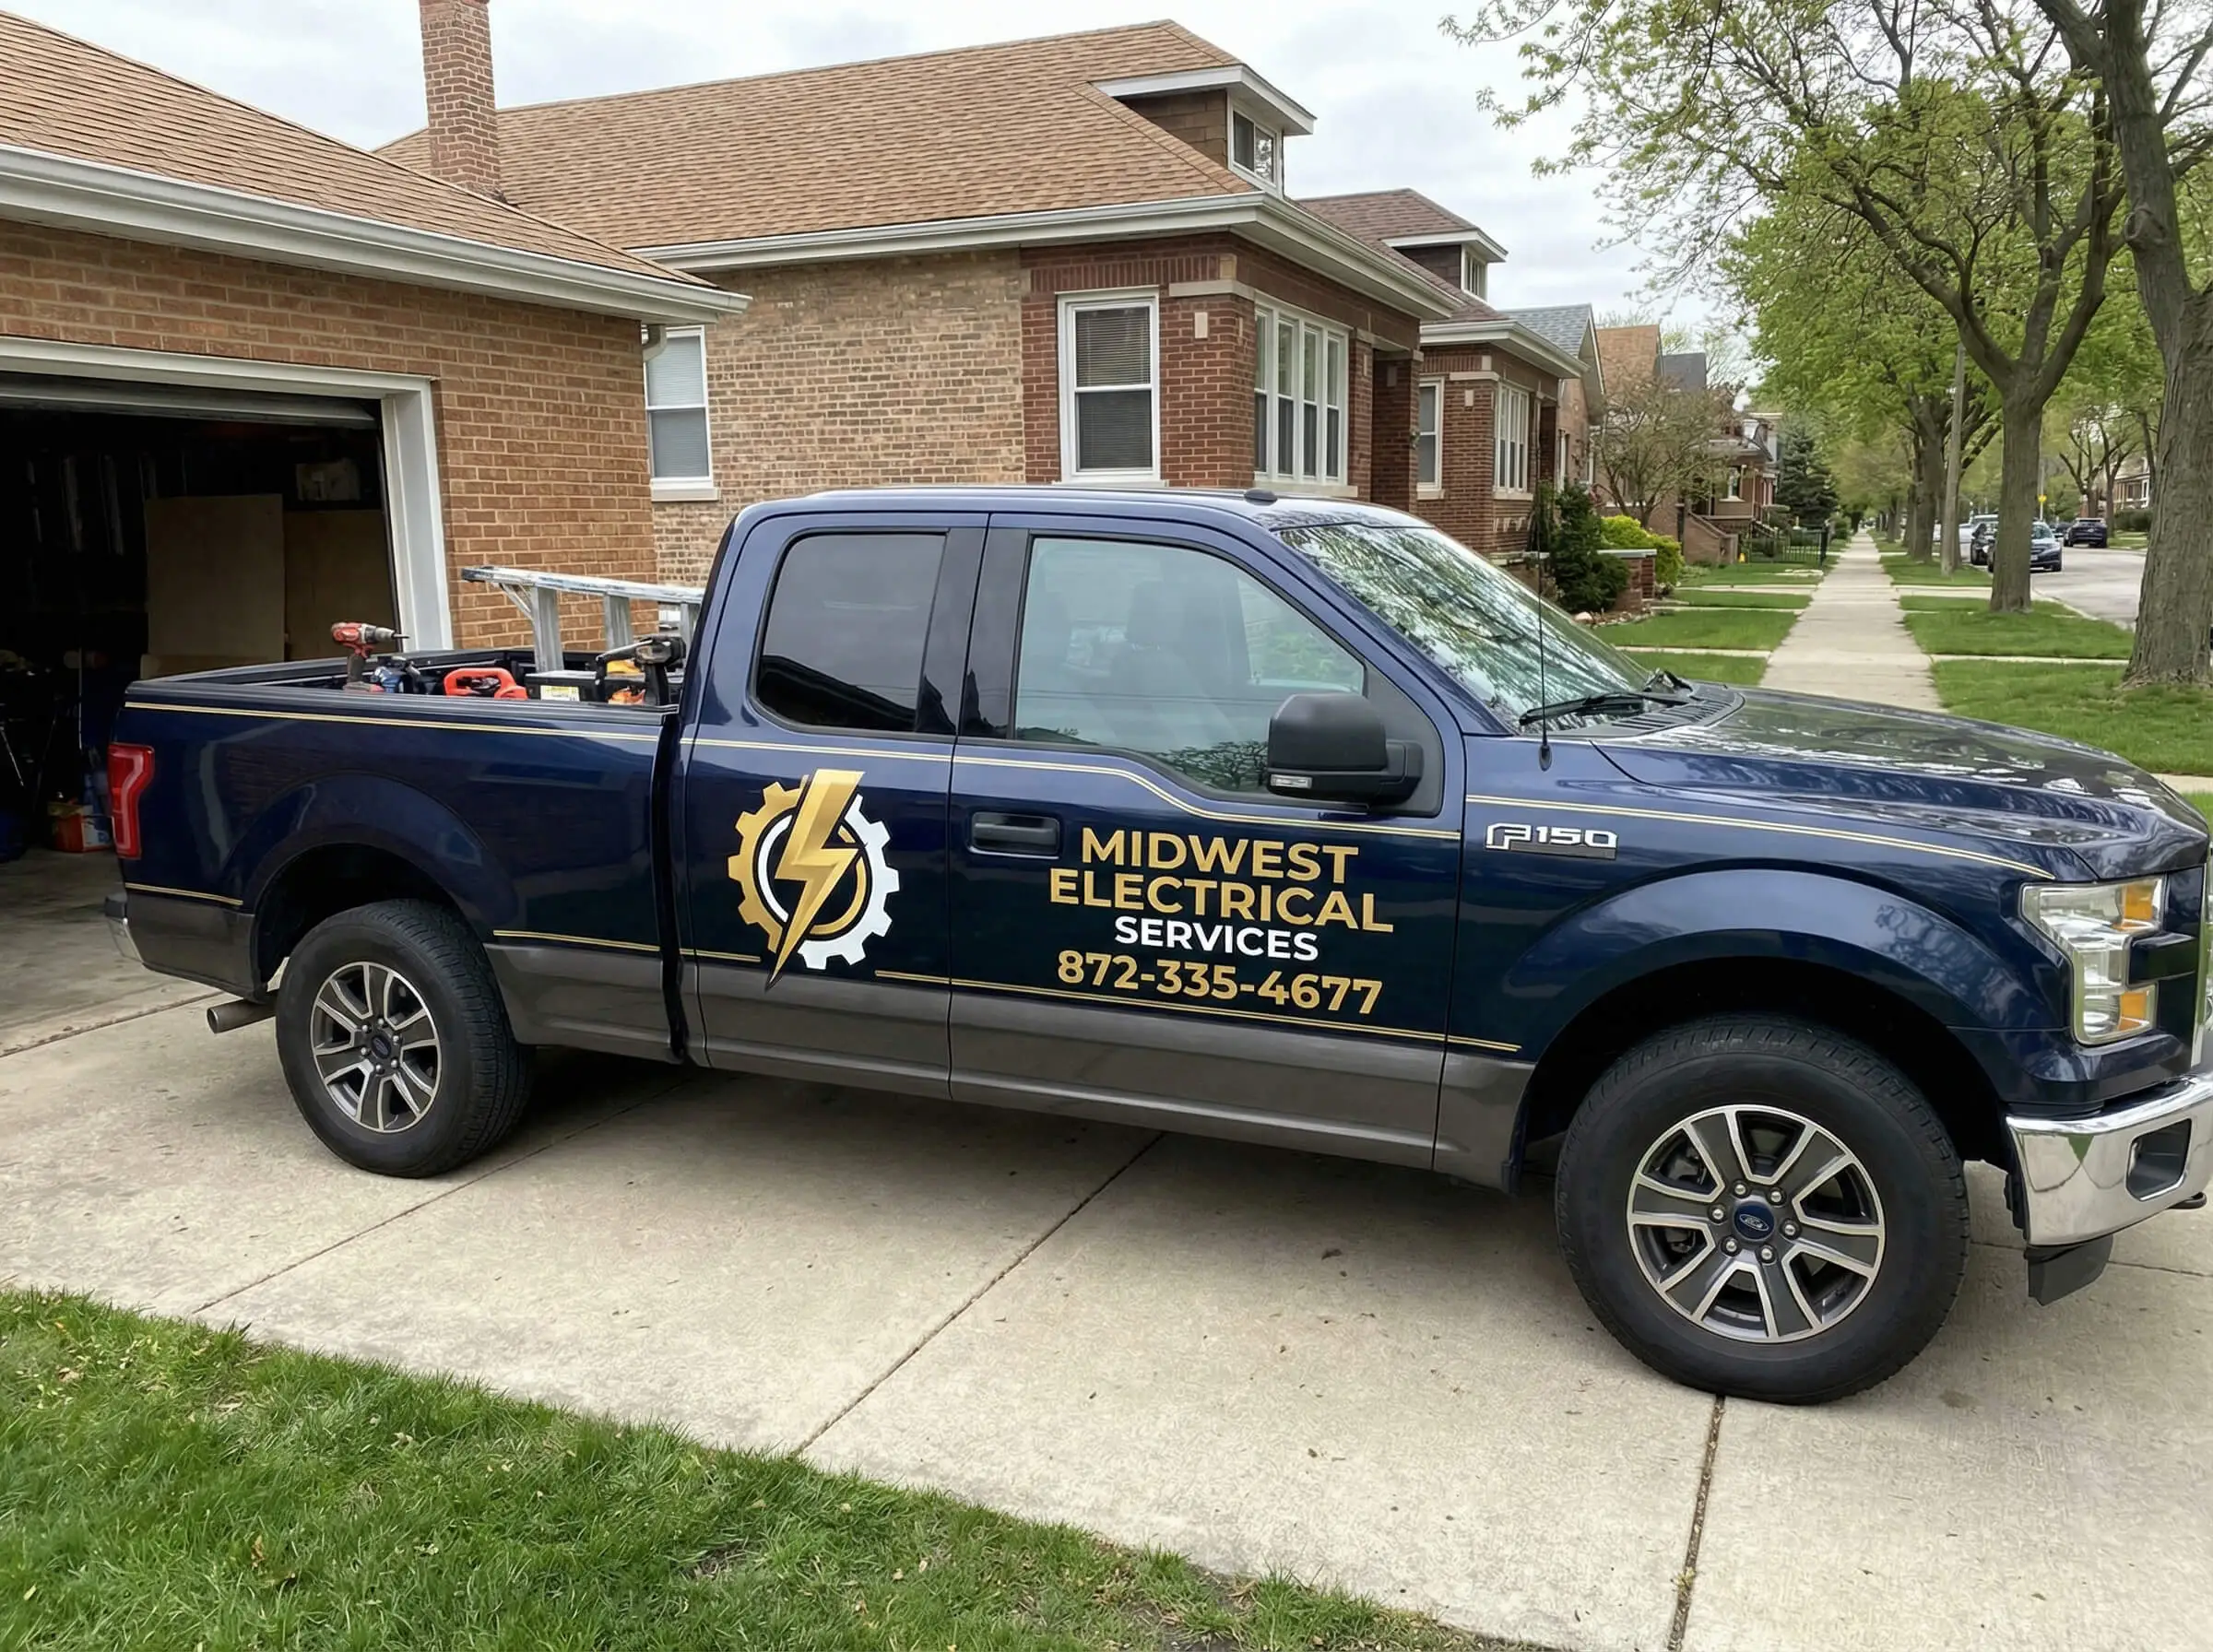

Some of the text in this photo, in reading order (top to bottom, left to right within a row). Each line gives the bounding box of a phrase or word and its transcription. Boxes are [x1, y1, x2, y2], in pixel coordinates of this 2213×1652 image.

[1082, 827, 1359, 884] MIDWEST
[1049, 867, 1394, 934] ELECTRICAL
[1114, 915, 1319, 962] SERVICES
[1057, 950, 1383, 1015] 872-335-4677
